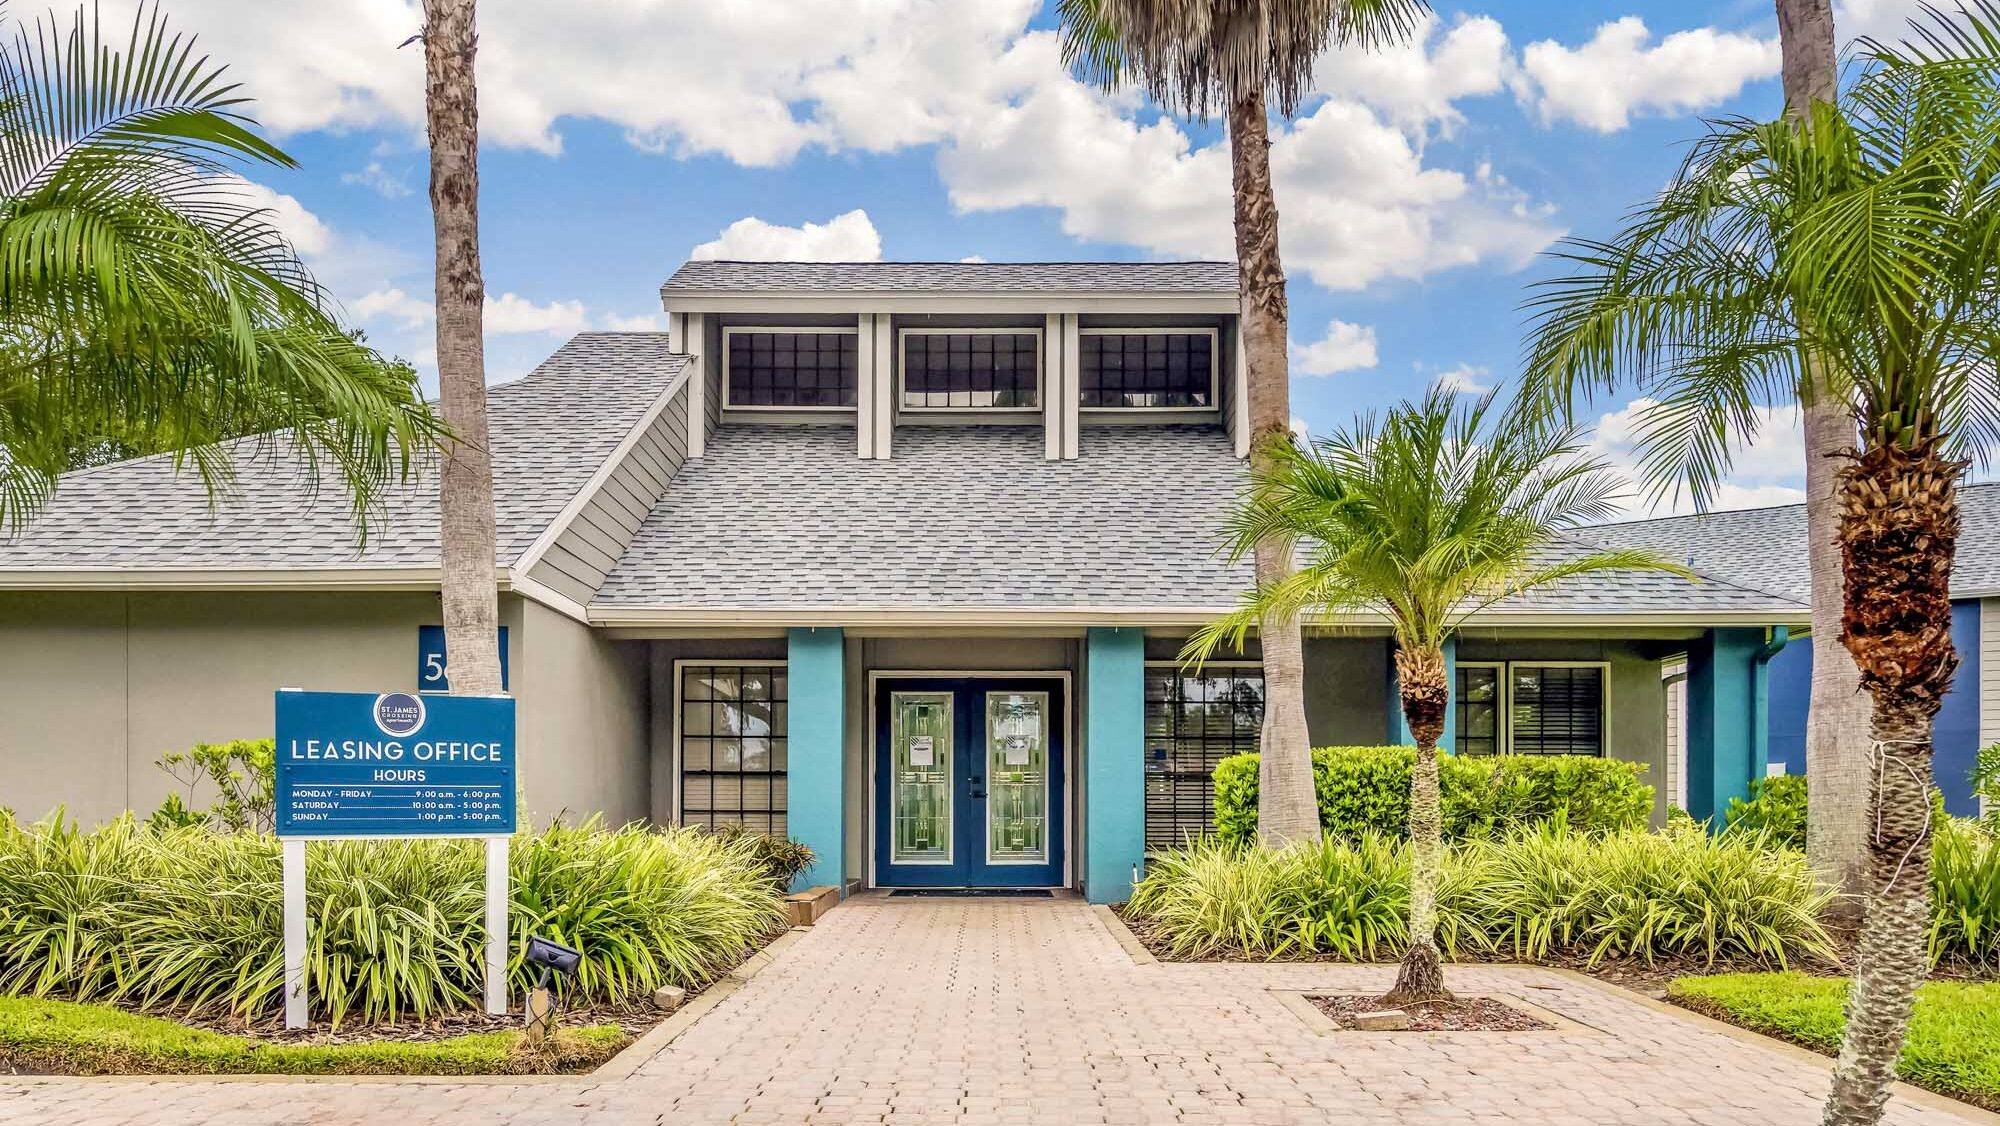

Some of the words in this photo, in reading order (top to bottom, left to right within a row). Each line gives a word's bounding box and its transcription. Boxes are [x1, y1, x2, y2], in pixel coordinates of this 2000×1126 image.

[424, 653, 448, 681] 5
[291, 740, 404, 760] LEASING
[414, 742, 501, 761] OFFICE
[374, 769, 426, 782] HOURS
[292, 790, 332, 798] MONDAY
[484, 792, 501, 800] p.m.
[484, 803, 501, 811] p.m.
[438, 814, 455, 822] p.m.
[484, 814, 501, 822] p.m.
